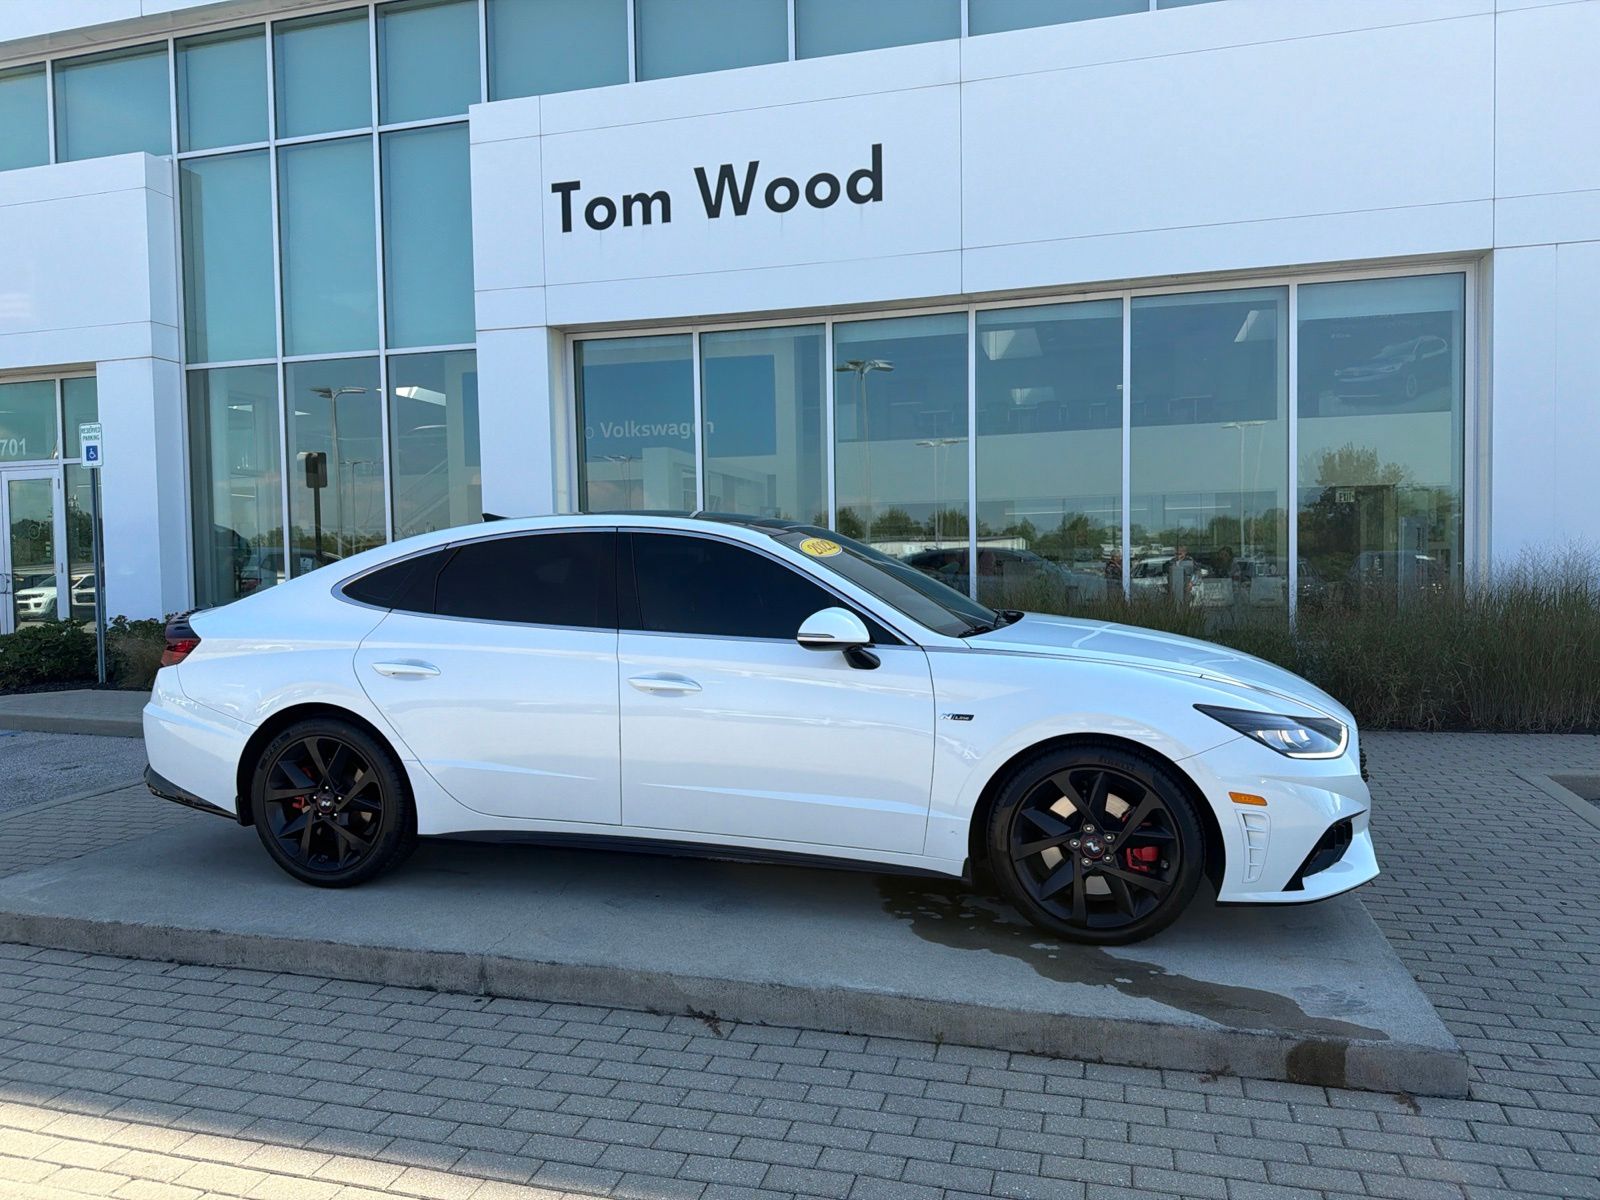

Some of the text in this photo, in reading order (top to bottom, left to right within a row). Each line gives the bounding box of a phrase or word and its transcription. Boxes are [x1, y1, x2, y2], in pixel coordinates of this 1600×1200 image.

[551, 143, 883, 233] Tom Wood
[600, 420, 714, 439] Volkswagn
[0, 437, 26, 456] 701
